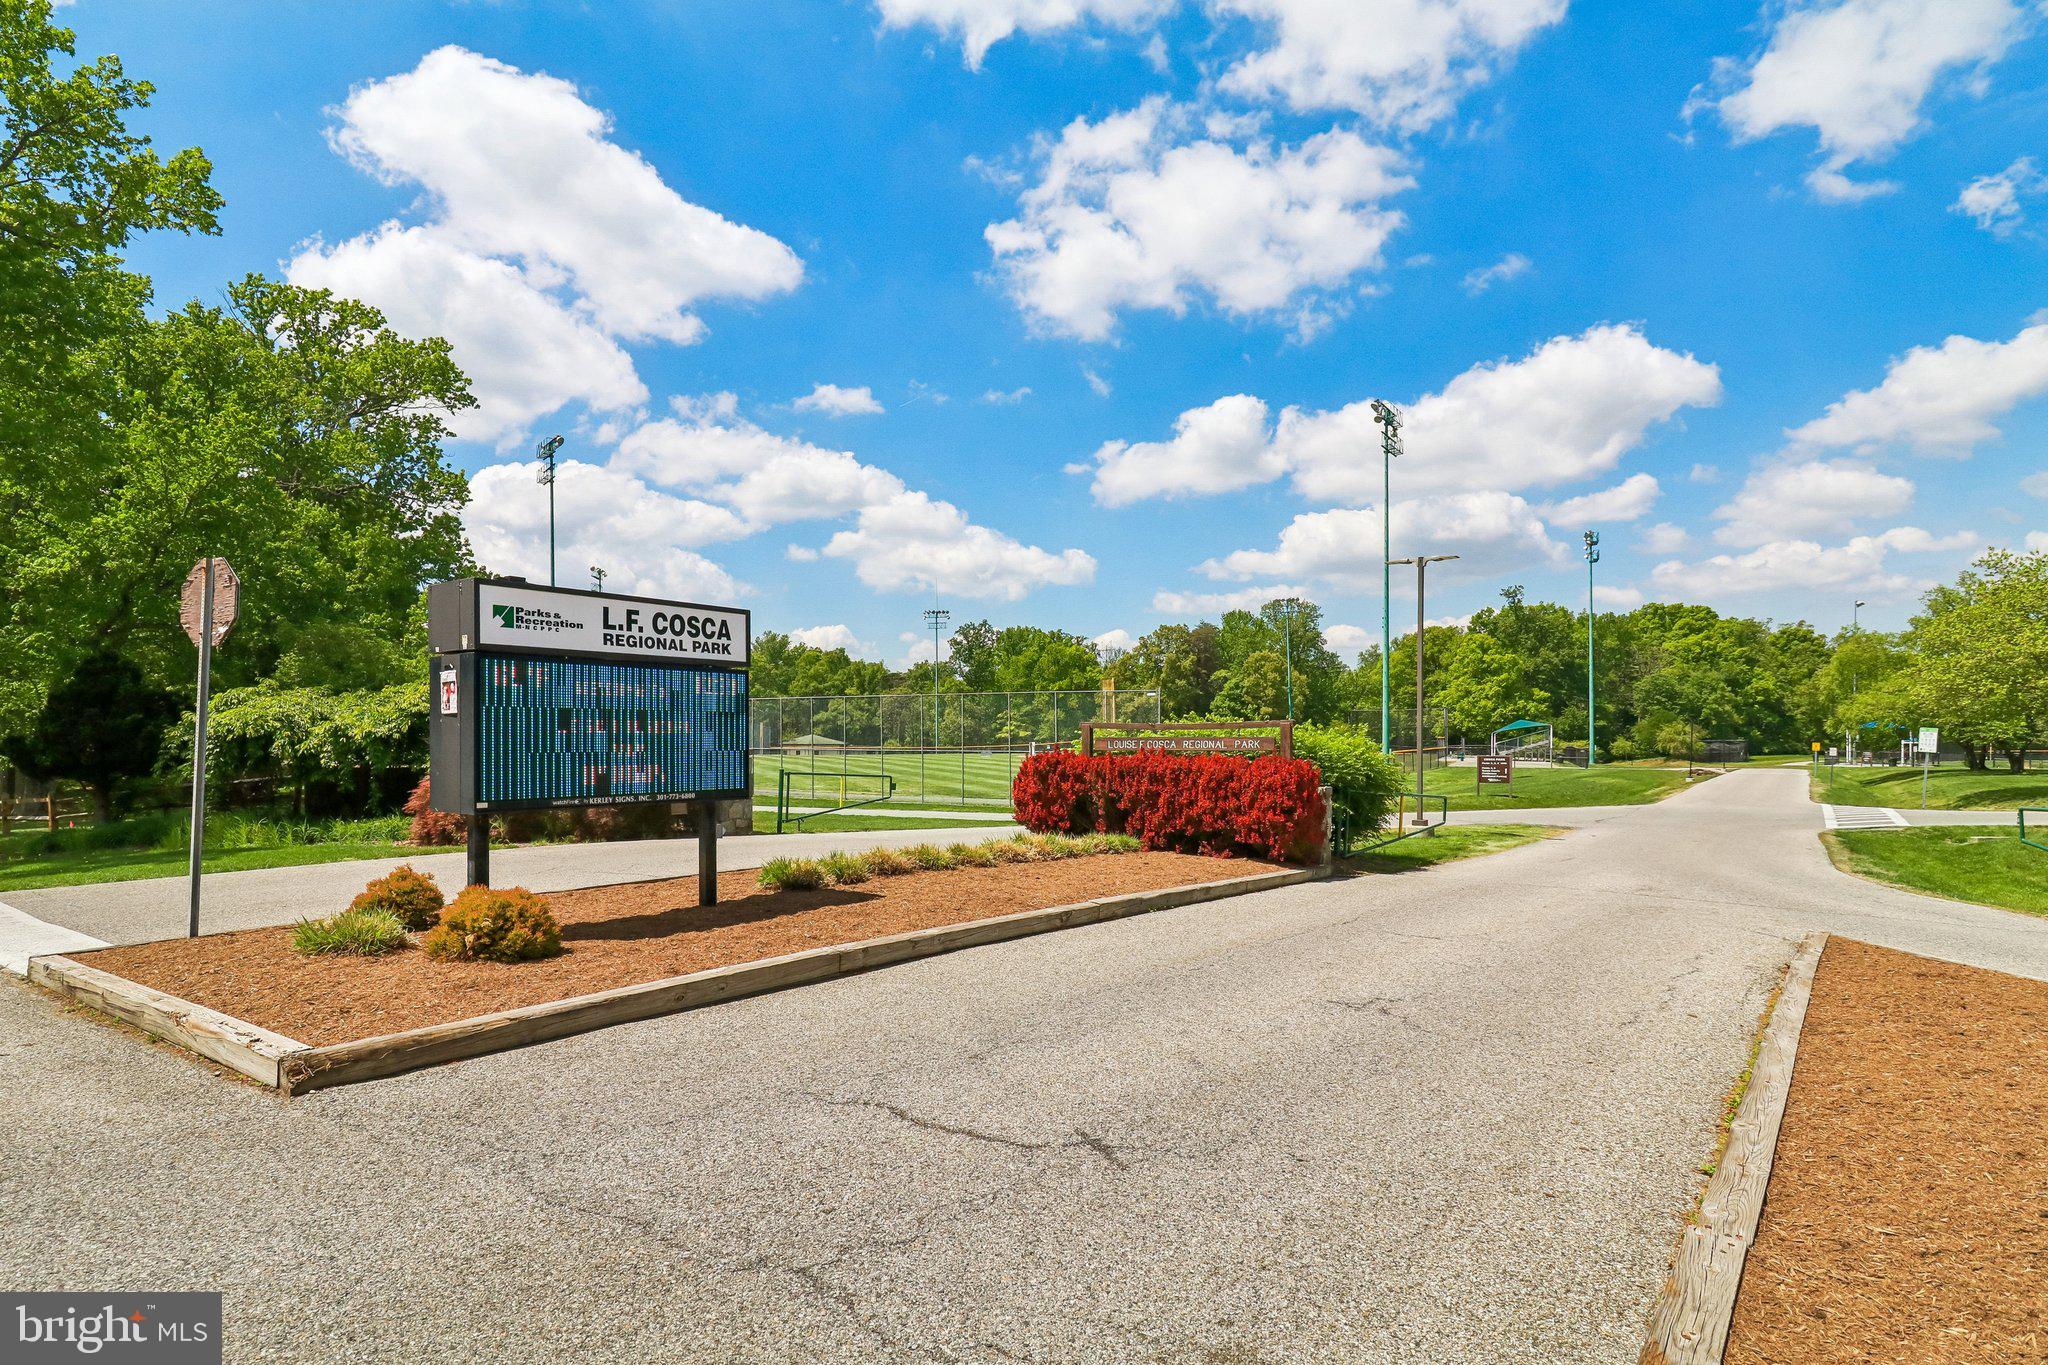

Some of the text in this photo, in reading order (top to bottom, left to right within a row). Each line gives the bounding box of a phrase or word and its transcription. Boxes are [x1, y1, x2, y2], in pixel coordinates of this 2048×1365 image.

[515, 606, 552, 619] Parks
[515, 615, 584, 629] Recreation
[602, 606, 732, 641] L.F. COSCA
[602, 632, 732, 655] REGIONAL PARK
[1107, 739, 1138, 749] LOUISE
[1146, 739, 1177, 749] COSCA
[1182, 739, 1228, 749] REGIONAL
[1234, 739, 1261, 749] PARK
[589, 796, 613, 804] KERLEY
[638, 794, 652, 802] INC.
